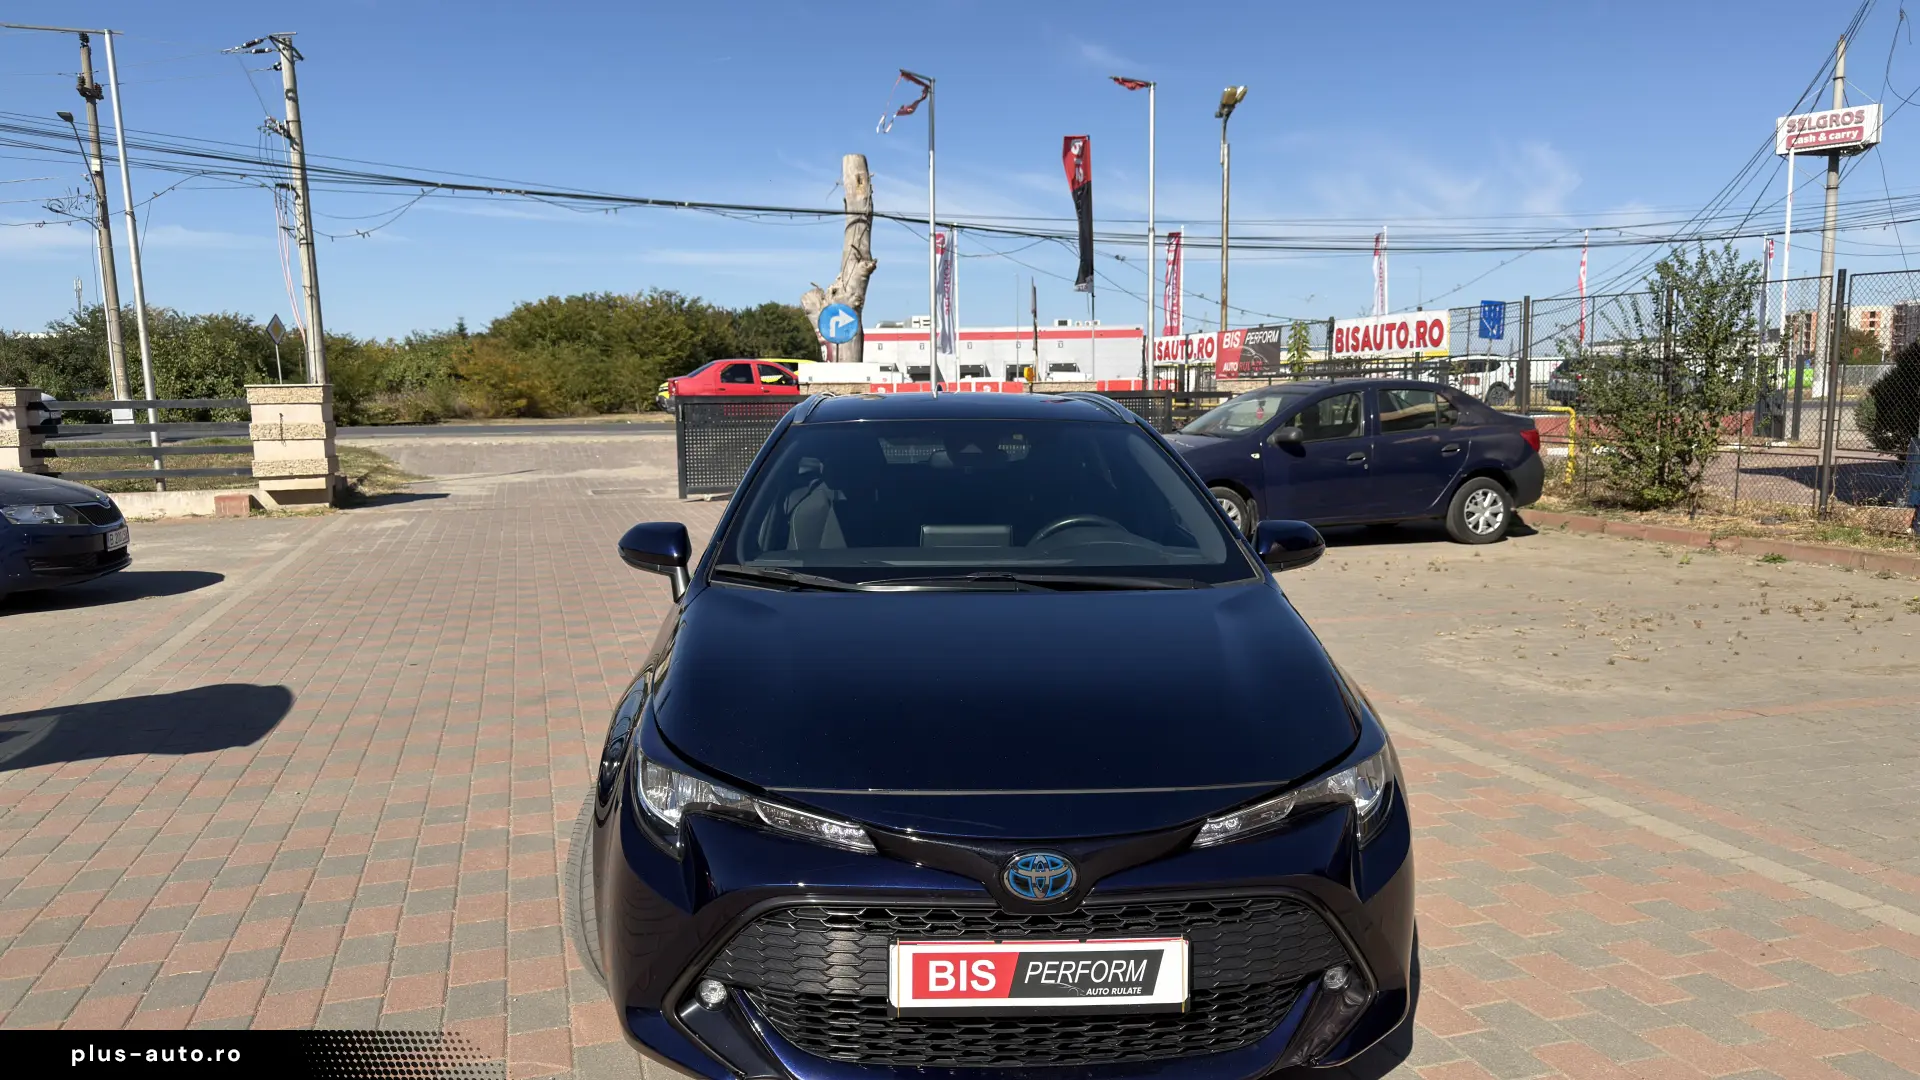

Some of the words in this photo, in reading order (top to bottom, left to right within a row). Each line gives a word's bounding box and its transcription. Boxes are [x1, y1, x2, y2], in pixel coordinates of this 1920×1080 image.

[1786, 109, 1865, 134] SELGROS
[1791, 132, 1816, 146] cash
[1817, 132, 1827, 142] &
[1829, 128, 1859, 141] carry
[1222, 331, 1241, 349] BIS
[1244, 329, 1279, 345] PERFORM
[1335, 318, 1444, 353] BISAUTO.RO
[1222, 361, 1239, 372] AUTO
[928, 959, 996, 992] BIS
[1024, 958, 1148, 984] PERFORM
[1085, 986, 1110, 996] AUTO
[1111, 985, 1142, 995] RULATE
